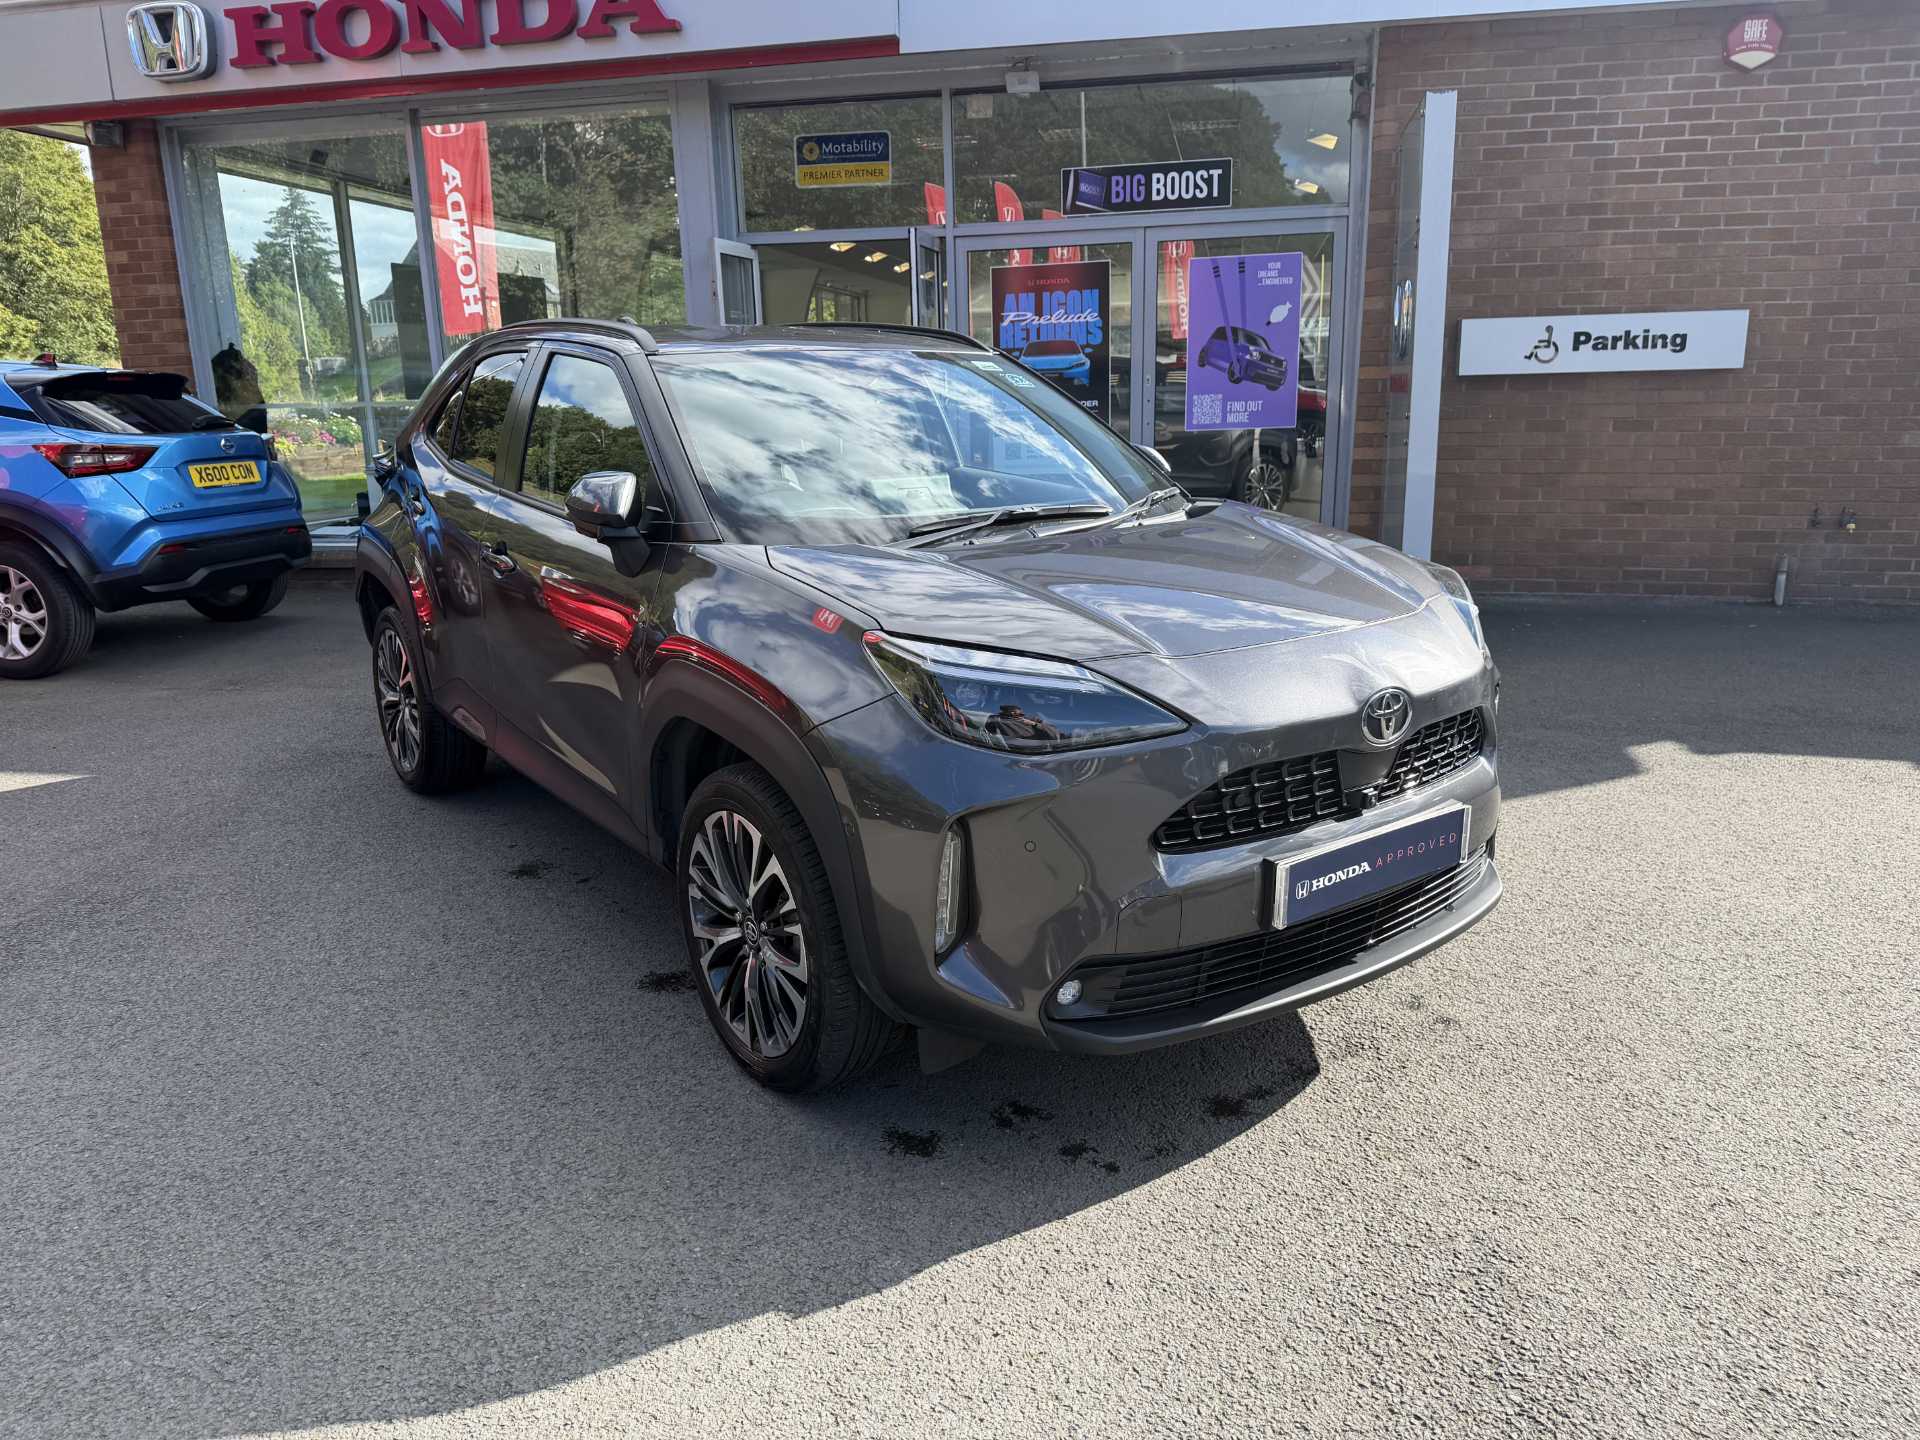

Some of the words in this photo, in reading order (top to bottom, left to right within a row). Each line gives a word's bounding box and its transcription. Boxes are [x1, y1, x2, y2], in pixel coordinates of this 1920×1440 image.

[223, 0, 683, 69] HONDA
[822, 139, 885, 154] Motability
[803, 170, 842, 181] PREMIER
[844, 168, 884, 179] PARTNER
[1111, 174, 1146, 203] BIG
[1151, 169, 1222, 201] BOOST
[1042, 288, 1100, 317] ICON
[1000, 308, 1100, 326] Prelude
[1572, 329, 1688, 353] Parking
[1226, 400, 1246, 412] FIND
[1247, 400, 1264, 411] OUT
[1226, 412, 1250, 423] MORE
[195, 464, 231, 484] X600
[231, 463, 255, 480] CON
[1311, 861, 1372, 892] HONDA
[1375, 832, 1457, 868] APPROVED
